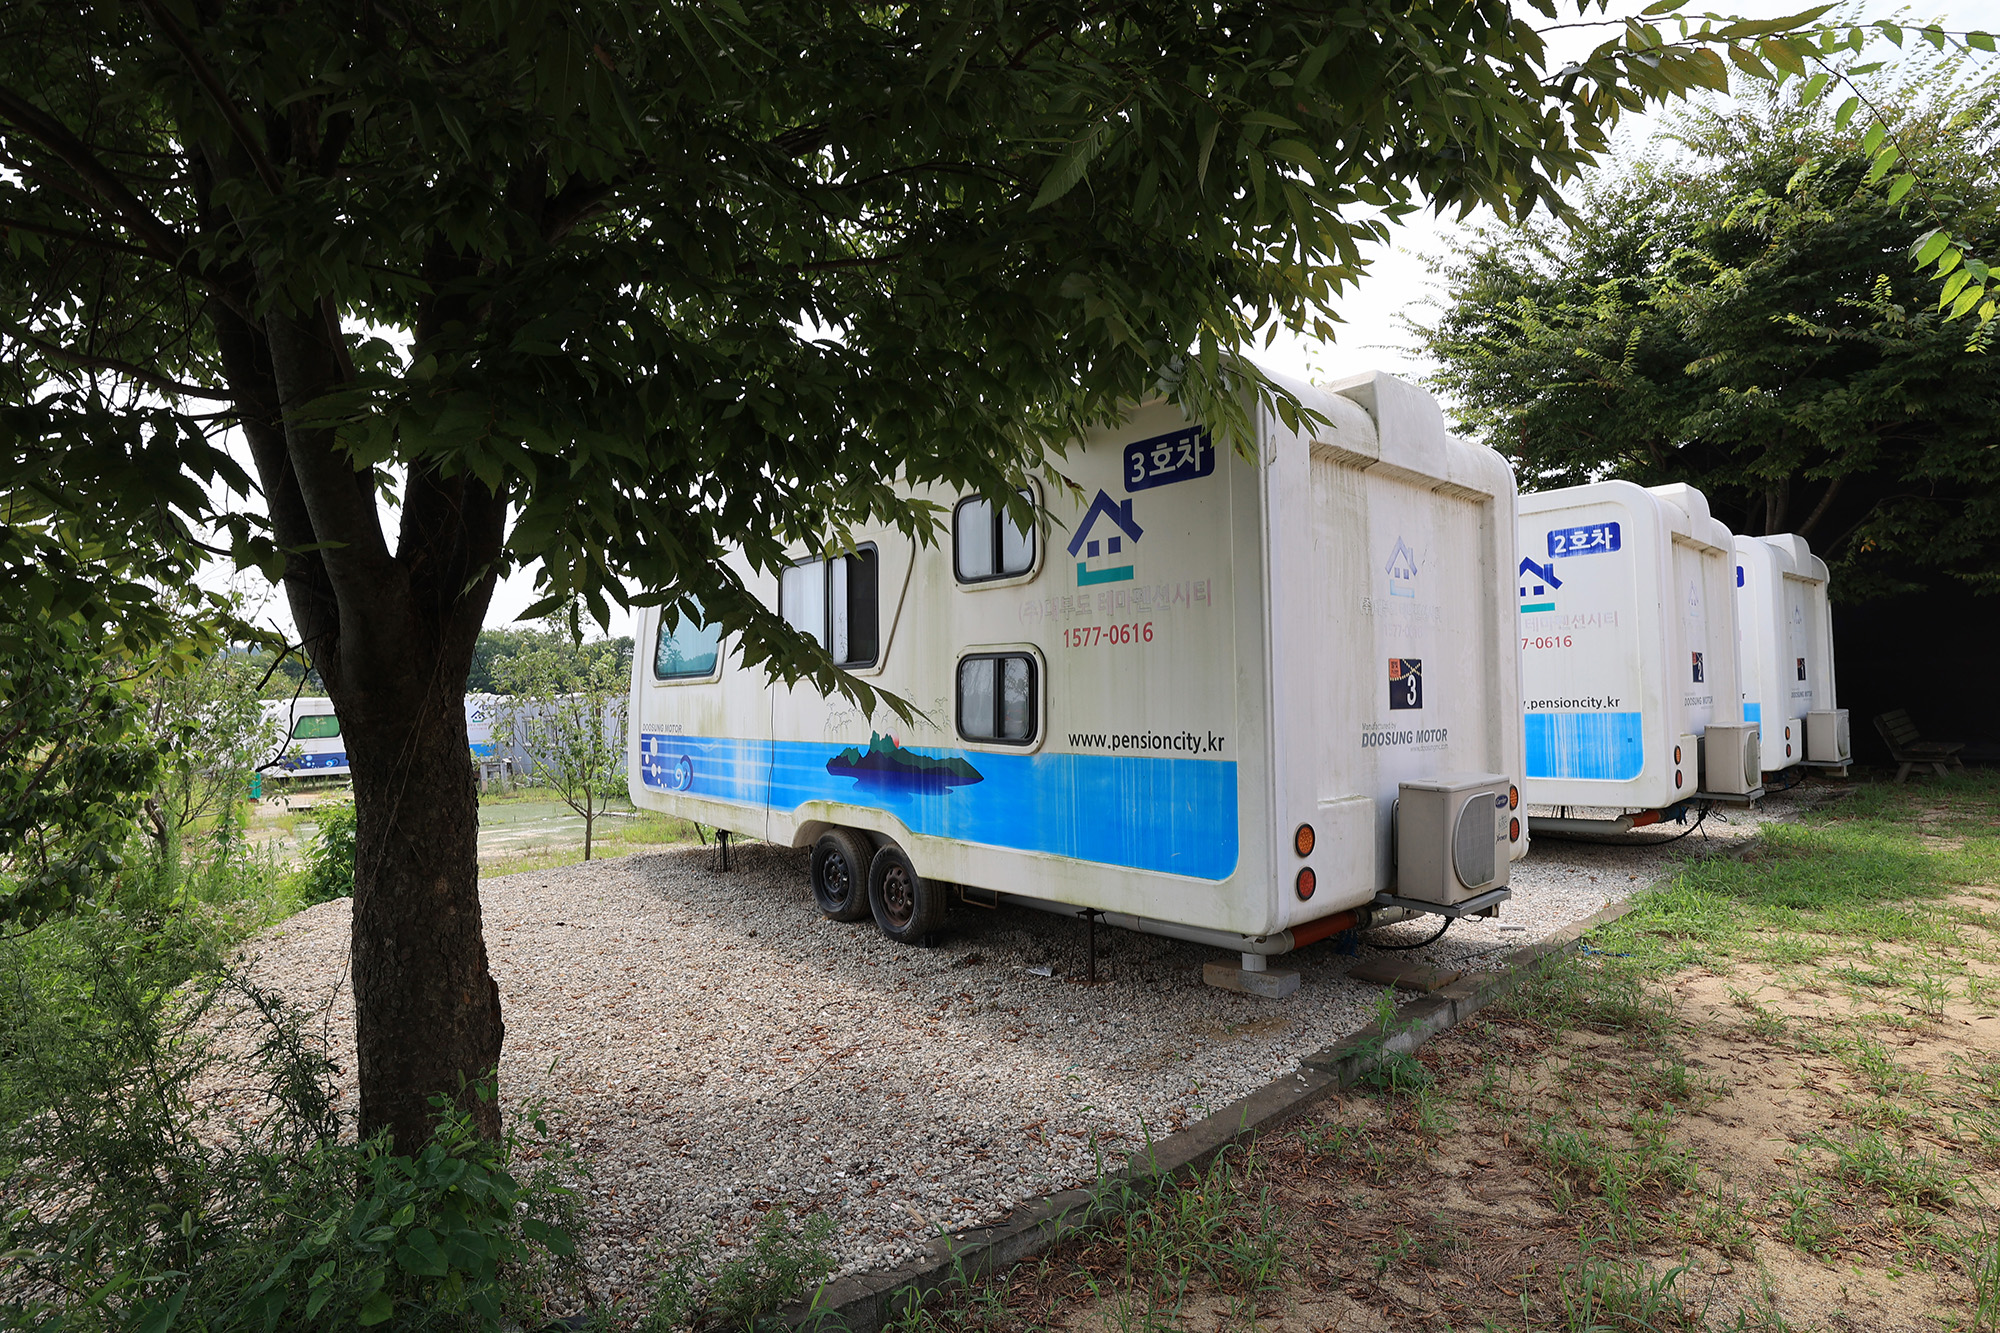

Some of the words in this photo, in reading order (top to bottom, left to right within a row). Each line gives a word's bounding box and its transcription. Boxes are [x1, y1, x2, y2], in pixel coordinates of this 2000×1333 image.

[1130, 434, 1205, 484] 3호차
[1554, 527, 1614, 554] 2호차
[1063, 622, 1154, 649] 1577-0616
[1406, 674, 1417, 706] 3
[1068, 730, 1225, 755] www.pensioncity.kr
[1361, 731, 1413, 748] DOOSUNG
[1416, 728, 1448, 744] MOTOR
